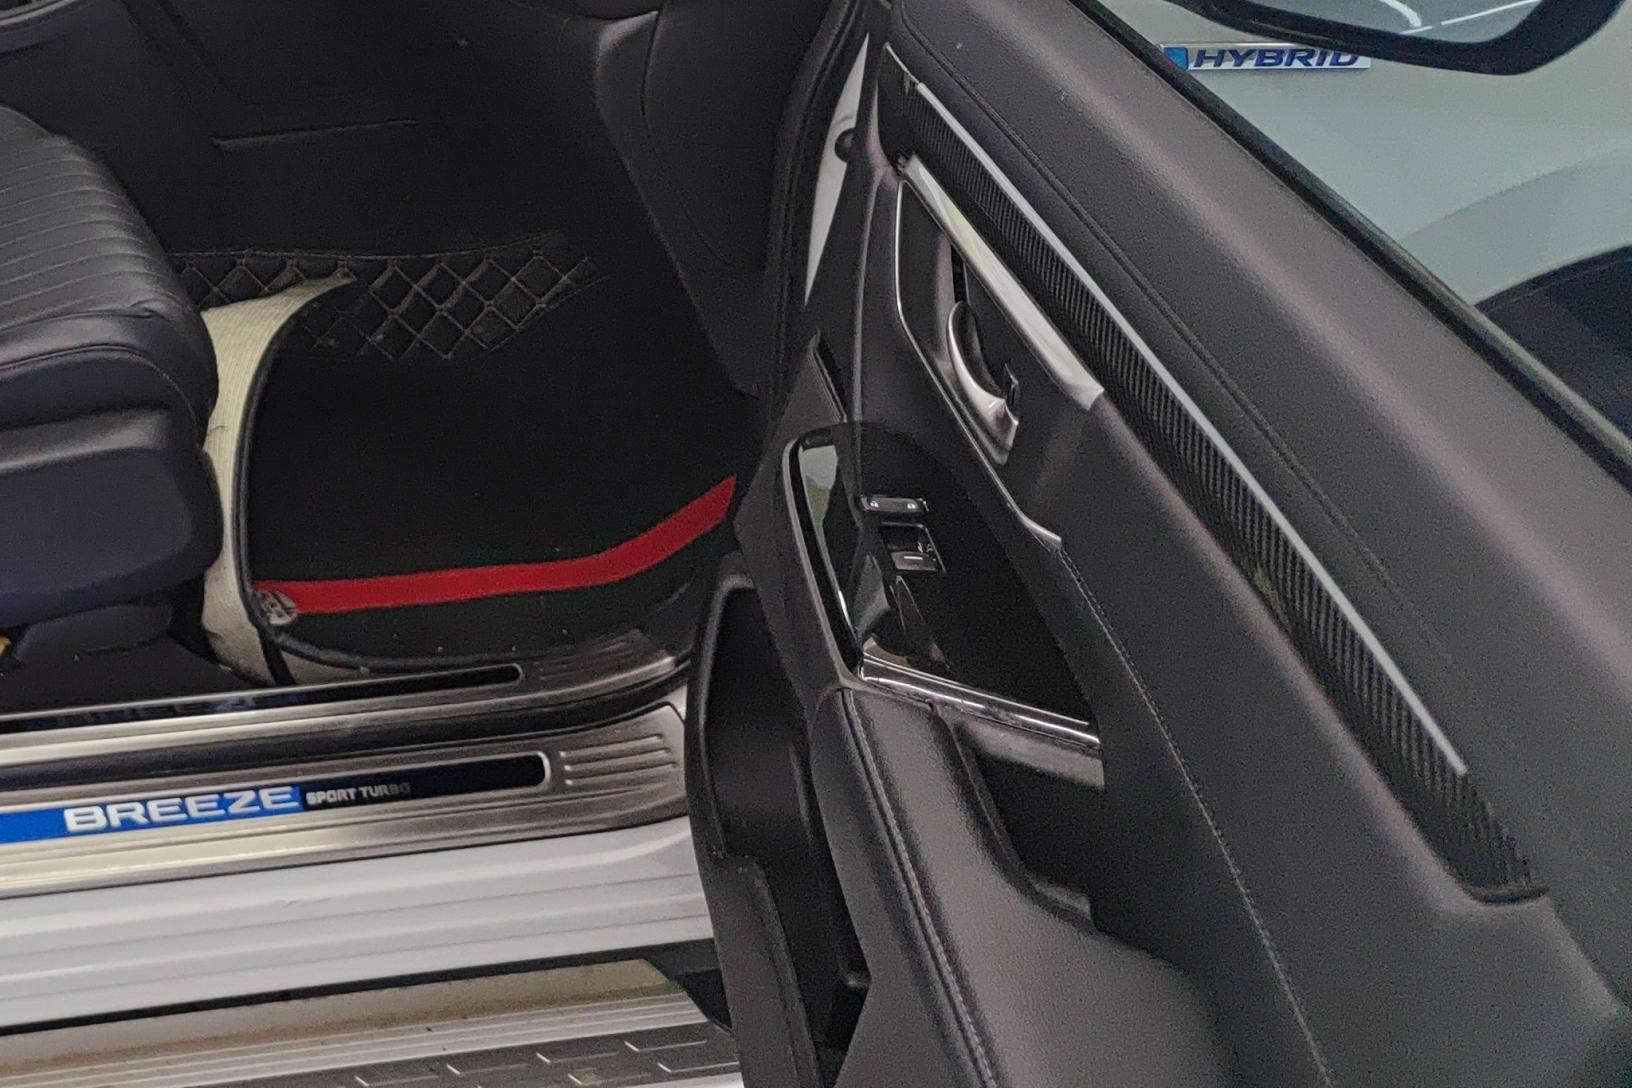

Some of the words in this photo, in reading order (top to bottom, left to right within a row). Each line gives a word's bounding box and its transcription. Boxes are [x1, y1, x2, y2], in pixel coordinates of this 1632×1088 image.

[1194, 48, 1359, 68] HYBRID
[64, 785, 299, 833] BREEZE
[306, 787, 358, 805] SPORT
[359, 782, 412, 799] TURBO
